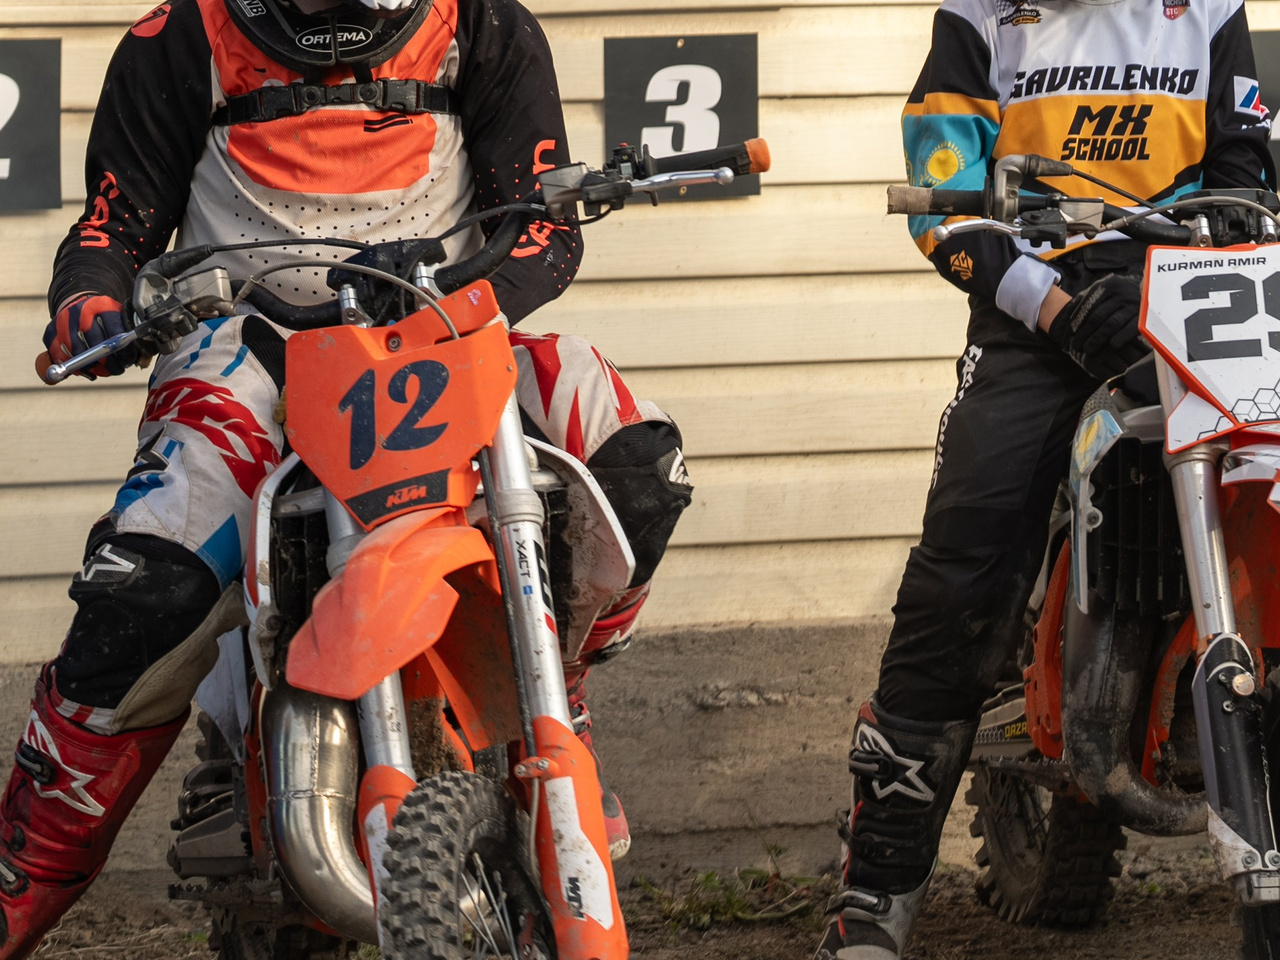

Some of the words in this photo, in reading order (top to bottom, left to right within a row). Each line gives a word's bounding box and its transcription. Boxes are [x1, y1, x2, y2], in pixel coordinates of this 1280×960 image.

[301, 30, 367, 46] ORTEMA
[1010, 63, 1200, 101] GAVRILENKO
[641, 63, 723, 161] 3
[1067, 104, 1154, 137] MX
[1060, 137, 1151, 162] SCHOOL
[1156, 258, 1224, 273] KURMAN
[1227, 256, 1267, 268] AMIR
[338, 359, 450, 471] 12
[385, 485, 428, 508] KTM
[515, 540, 532, 579] XACT
[566, 876, 585, 919] KTM
